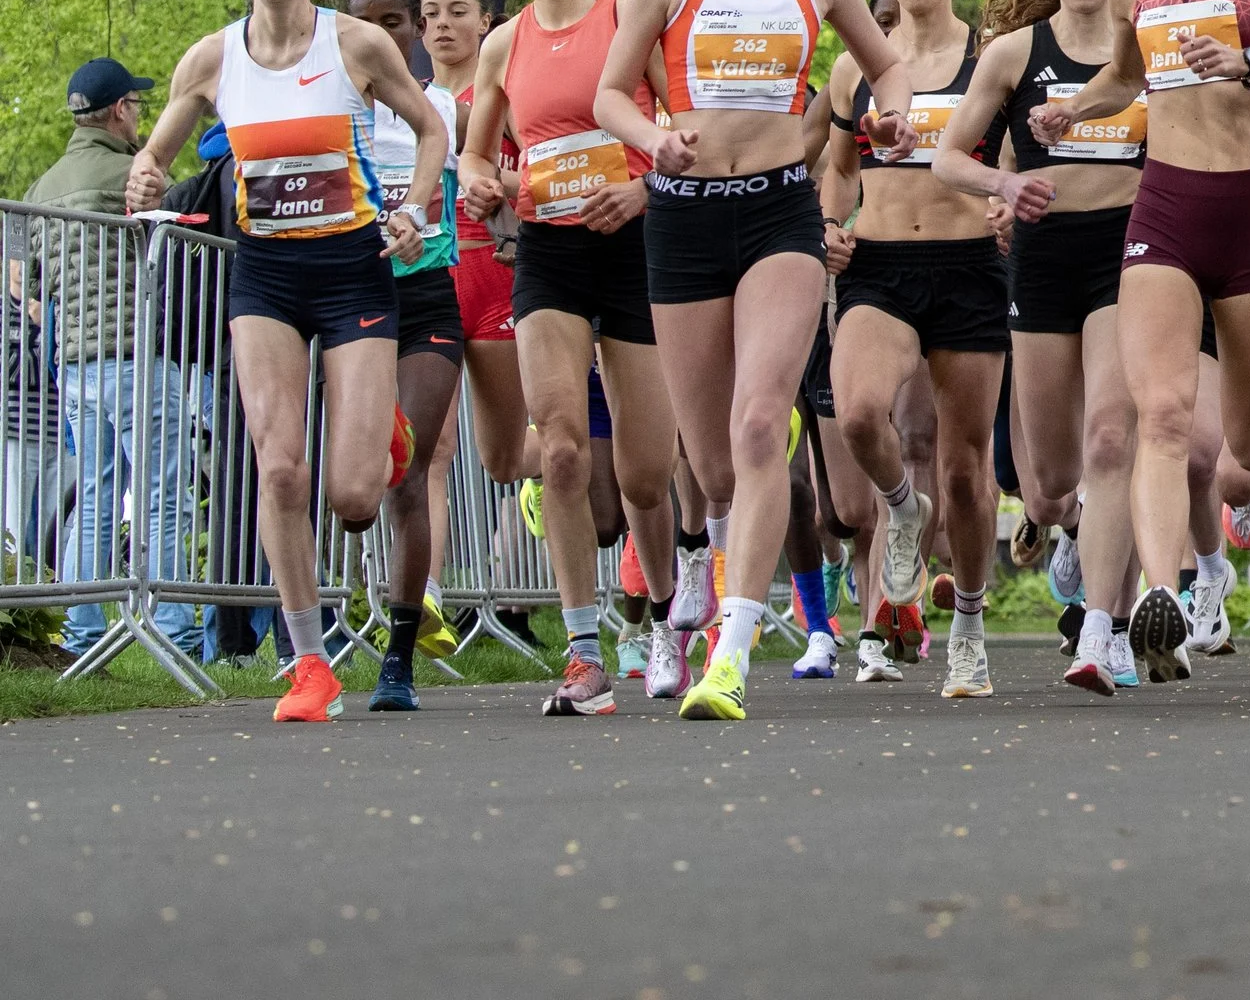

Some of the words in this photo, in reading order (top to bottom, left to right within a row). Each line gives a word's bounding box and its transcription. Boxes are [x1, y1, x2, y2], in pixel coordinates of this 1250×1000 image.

[1213, 2, 1229, 13] NK
[761, 21, 776, 30] NK
[778, 21, 798, 31] U20
[733, 38, 768, 53] 262
[712, 58, 787, 76] Valerie
[773, 83, 794, 93] 2026
[1071, 121, 1131, 139] Tessa
[556, 154, 589, 172] 202
[284, 176, 307, 192] 69
[549, 173, 607, 198] Ineke
[653, 172, 700, 197] NIKE
[703, 176, 769, 198] PRO
[382, 187, 408, 201] 247
[272, 198, 324, 217] Jana
